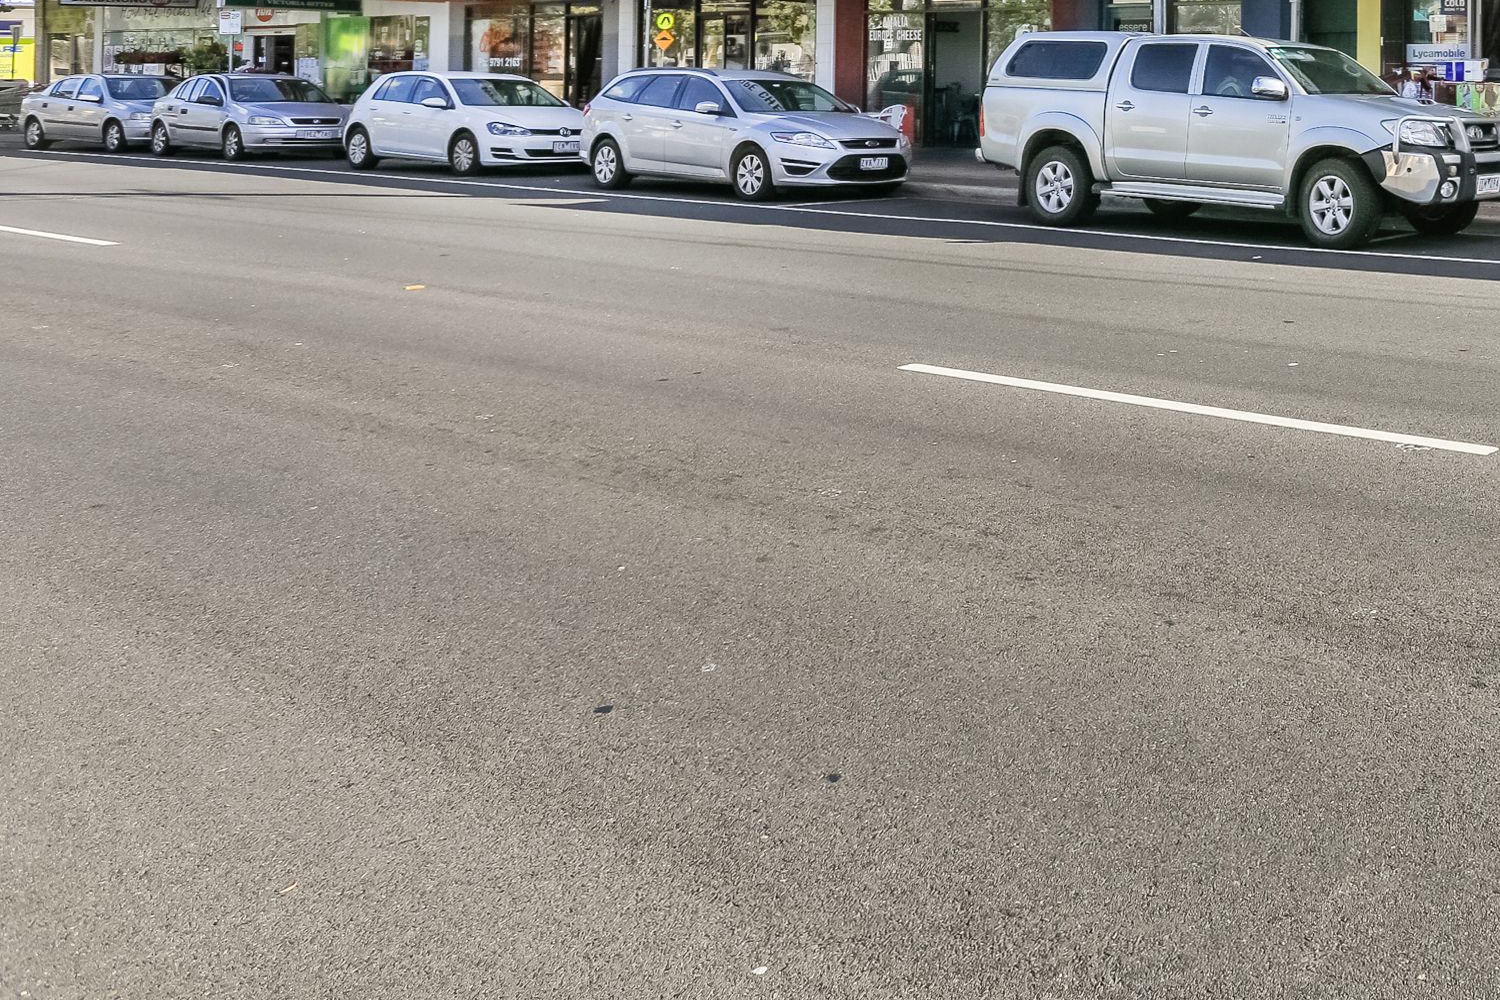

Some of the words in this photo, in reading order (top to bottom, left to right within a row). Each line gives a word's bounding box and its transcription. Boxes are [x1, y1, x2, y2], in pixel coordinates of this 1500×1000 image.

[1444, 0, 1466, 7] COLD
[882, 16, 908, 27] AMALIA
[1119, 23, 1148, 32] essere
[869, 29, 894, 41] EUROPE
[896, 29, 922, 41] CHEESE
[1412, 49, 1466, 59] Lycamobile
